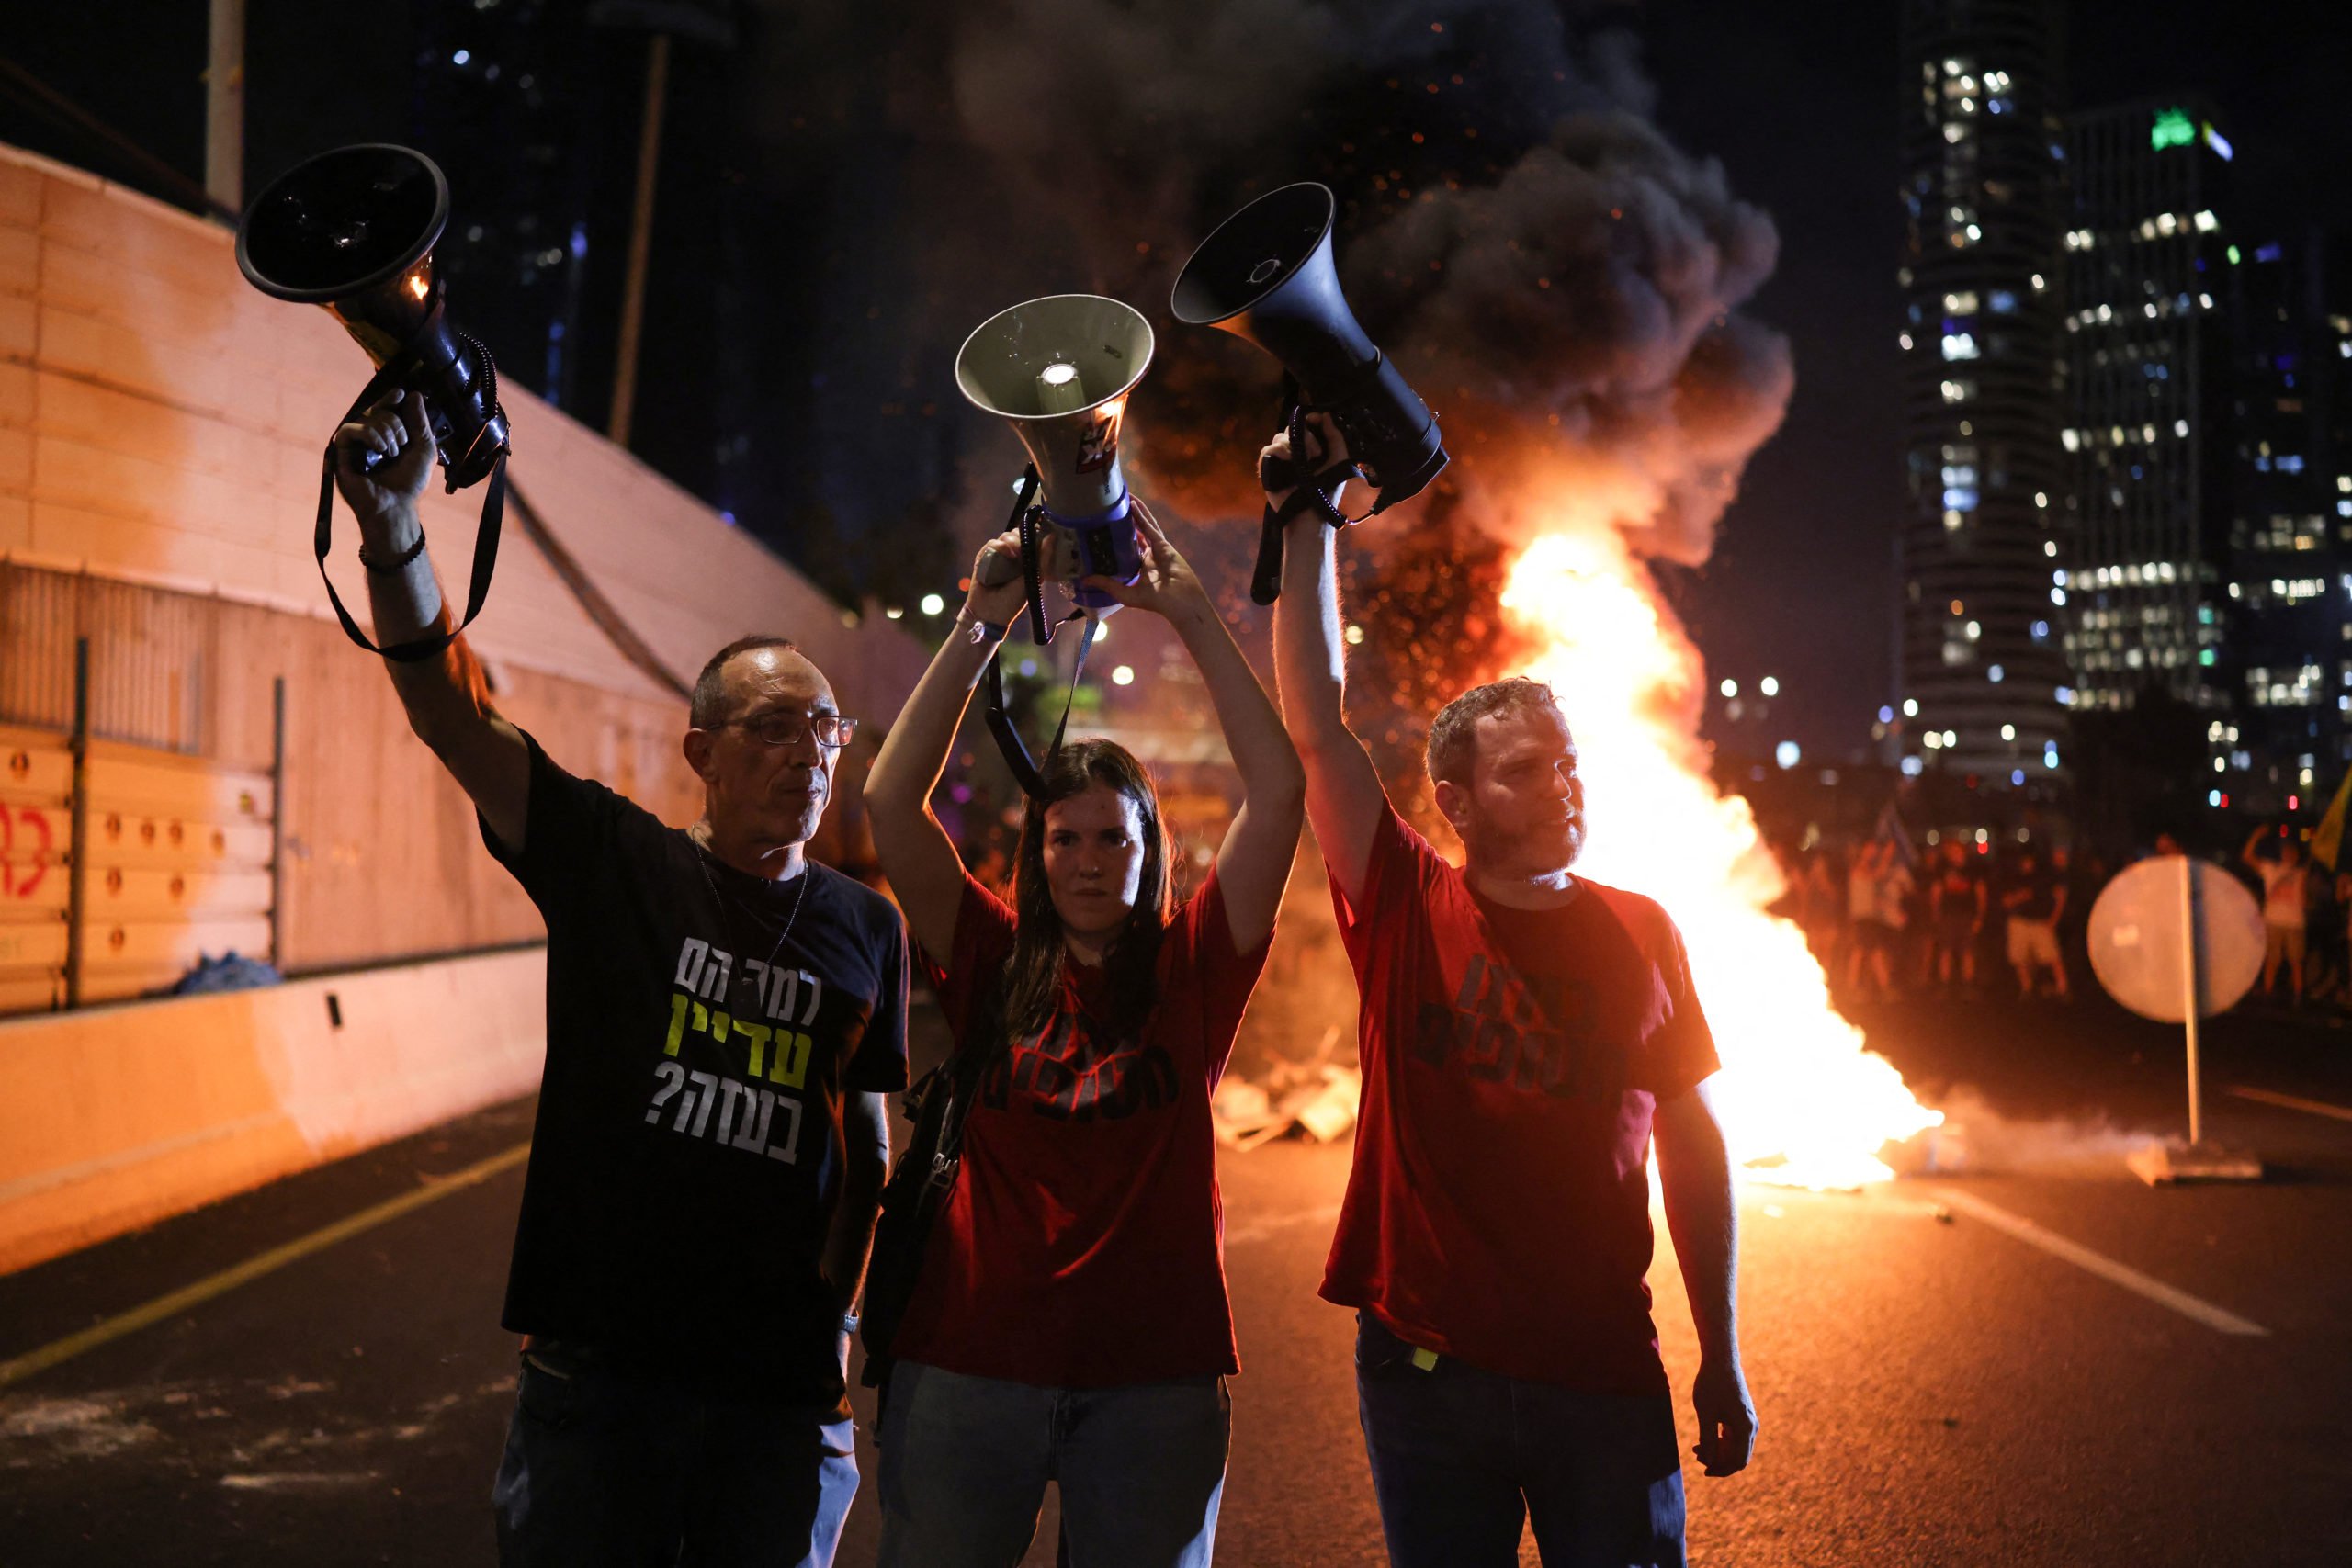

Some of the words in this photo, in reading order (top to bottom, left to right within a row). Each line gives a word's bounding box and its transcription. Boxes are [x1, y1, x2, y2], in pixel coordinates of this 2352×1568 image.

[674, 937, 733, 1003] הם
[663, 993, 812, 1090] עדיין
[645, 1061, 802, 1166] בעזה?
